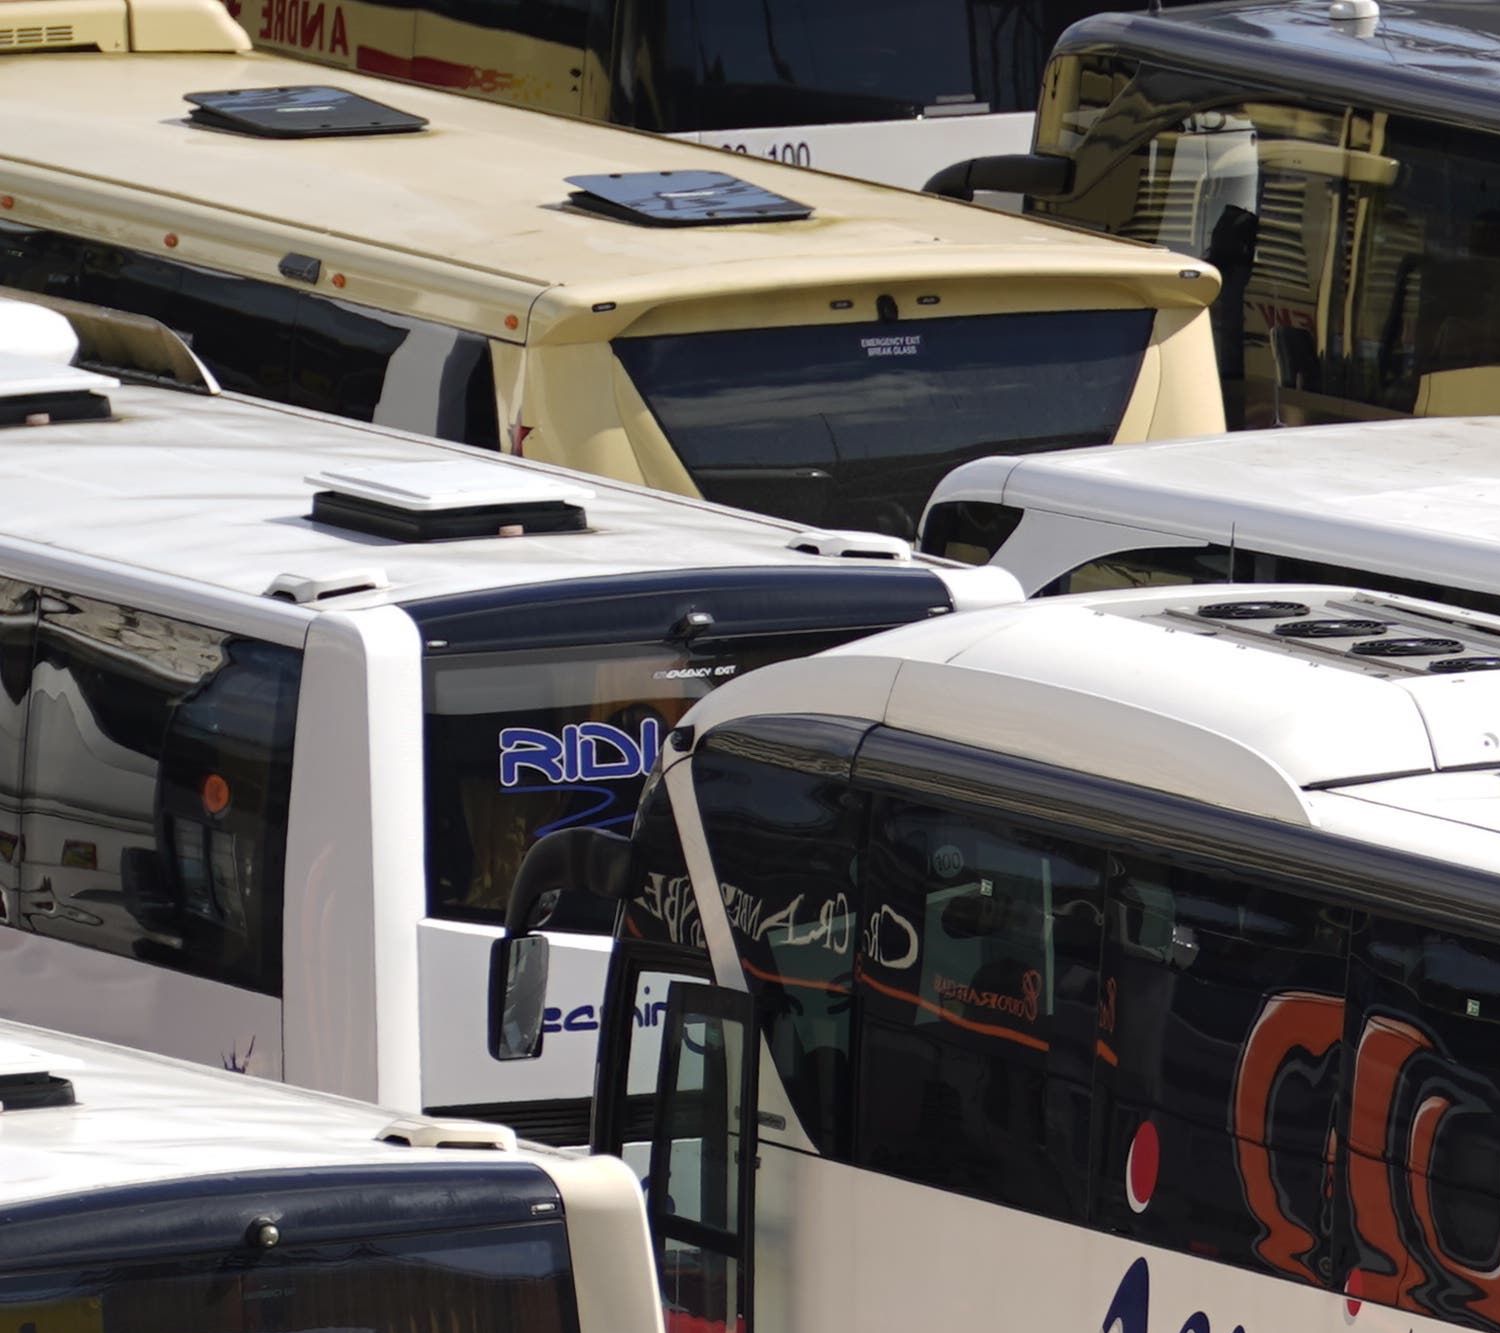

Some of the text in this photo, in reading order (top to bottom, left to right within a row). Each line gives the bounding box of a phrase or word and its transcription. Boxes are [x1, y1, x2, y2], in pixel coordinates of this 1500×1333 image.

[861, 336, 921, 348] EMERGENCY EXIT
[867, 345, 917, 357] BREAK GLASS
